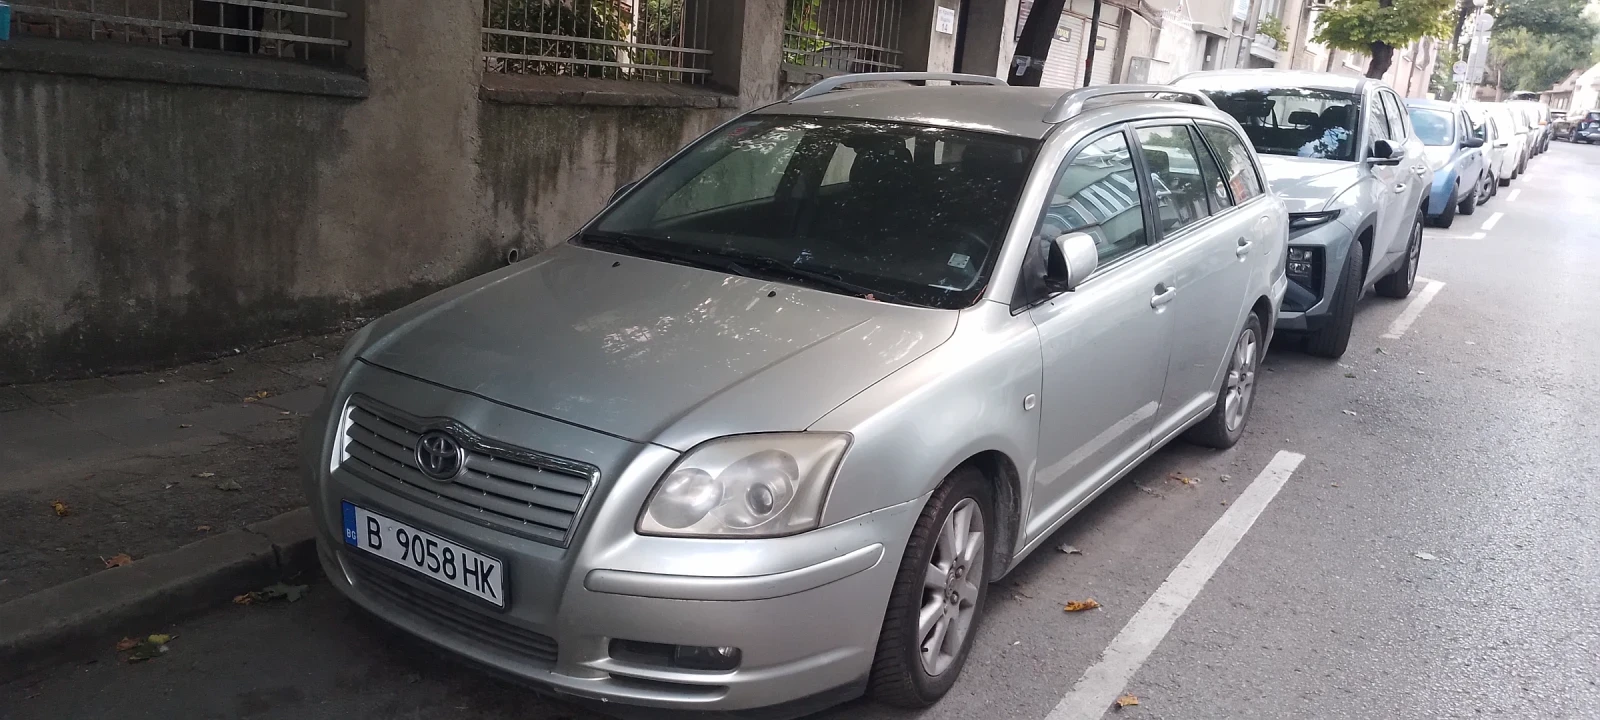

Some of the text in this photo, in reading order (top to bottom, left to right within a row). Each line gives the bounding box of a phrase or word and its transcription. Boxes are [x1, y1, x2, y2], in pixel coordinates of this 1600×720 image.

[346, 528, 357, 540] BG
[366, 516, 497, 599] B 9058 HK
